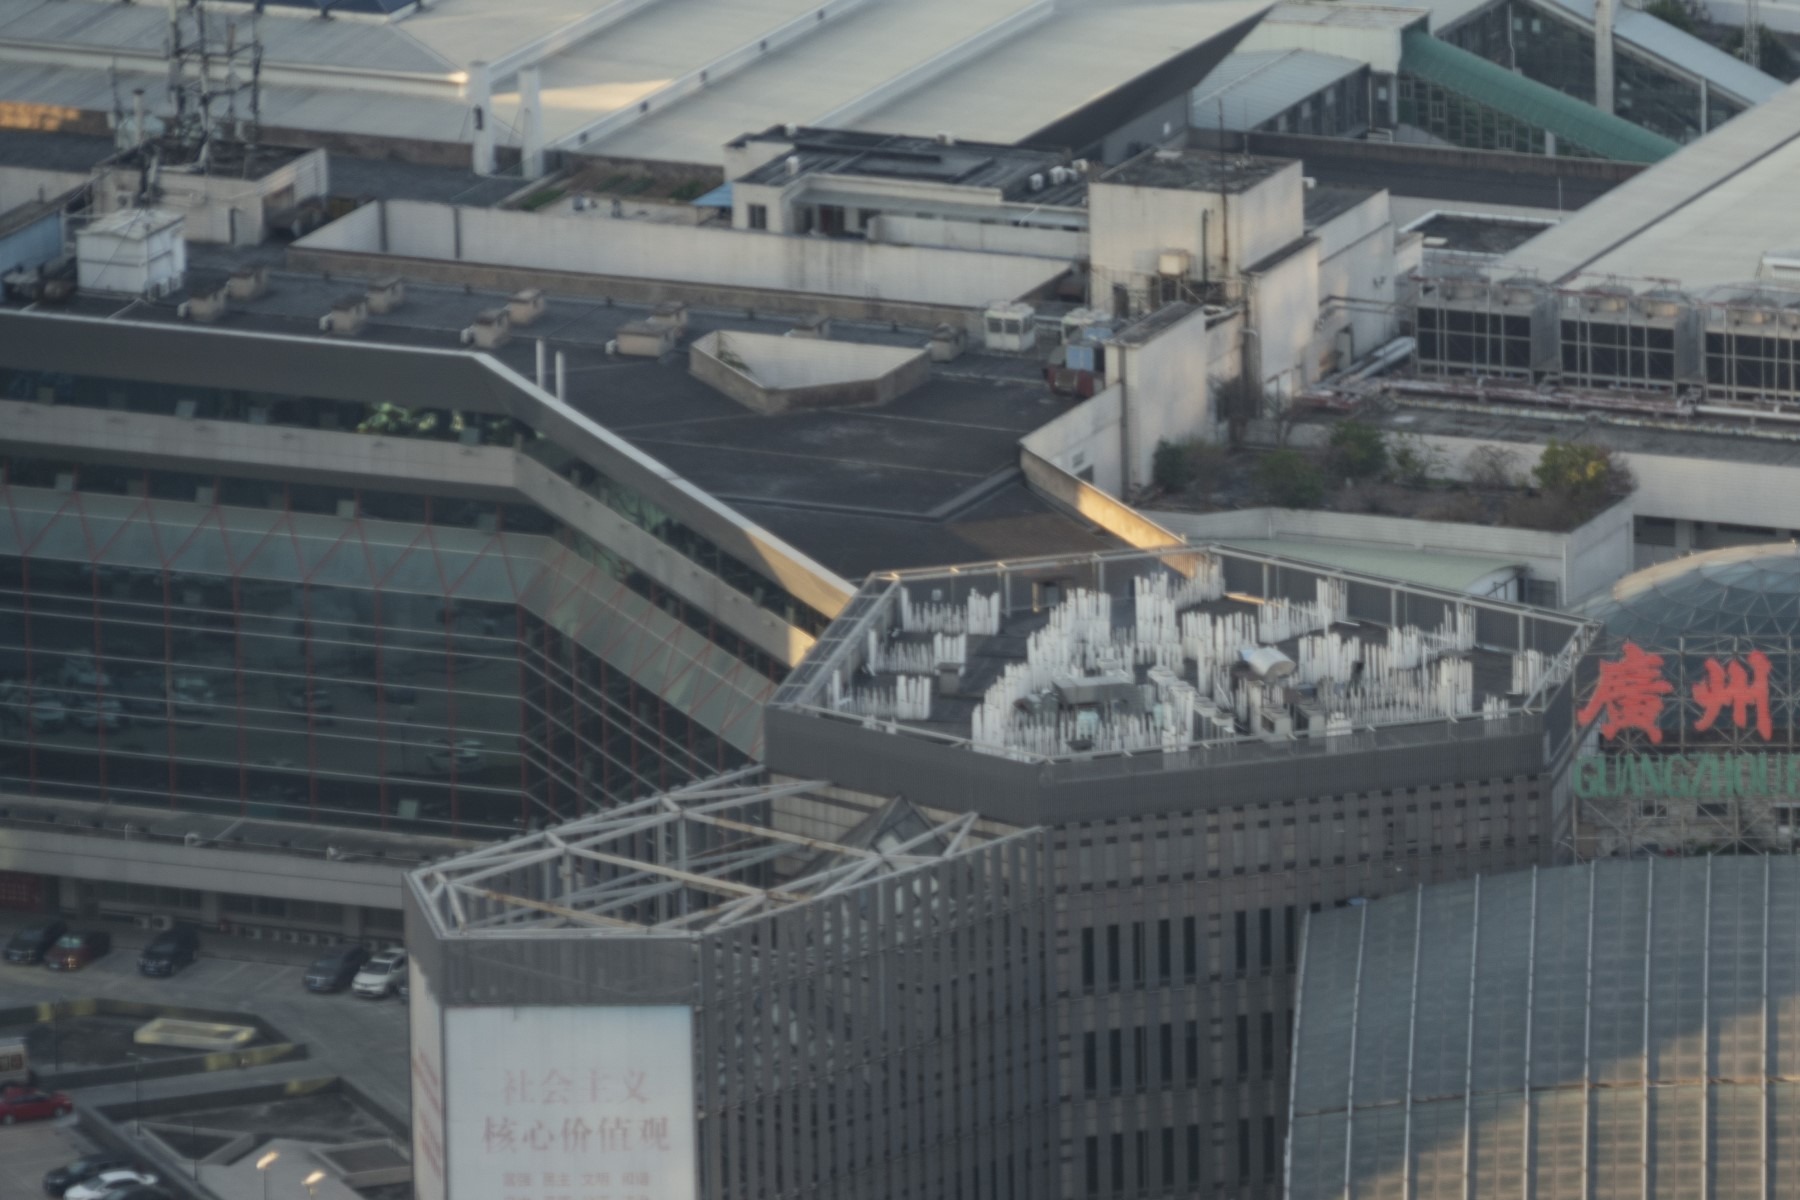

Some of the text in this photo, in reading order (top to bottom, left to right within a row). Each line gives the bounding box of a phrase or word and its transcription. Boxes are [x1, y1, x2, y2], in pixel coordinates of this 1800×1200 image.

[1573, 752, 1781, 797] GUANGZHOU
[504, 1067, 650, 1105] 社会主义
[482, 1116, 670, 1153] 核心价值观
